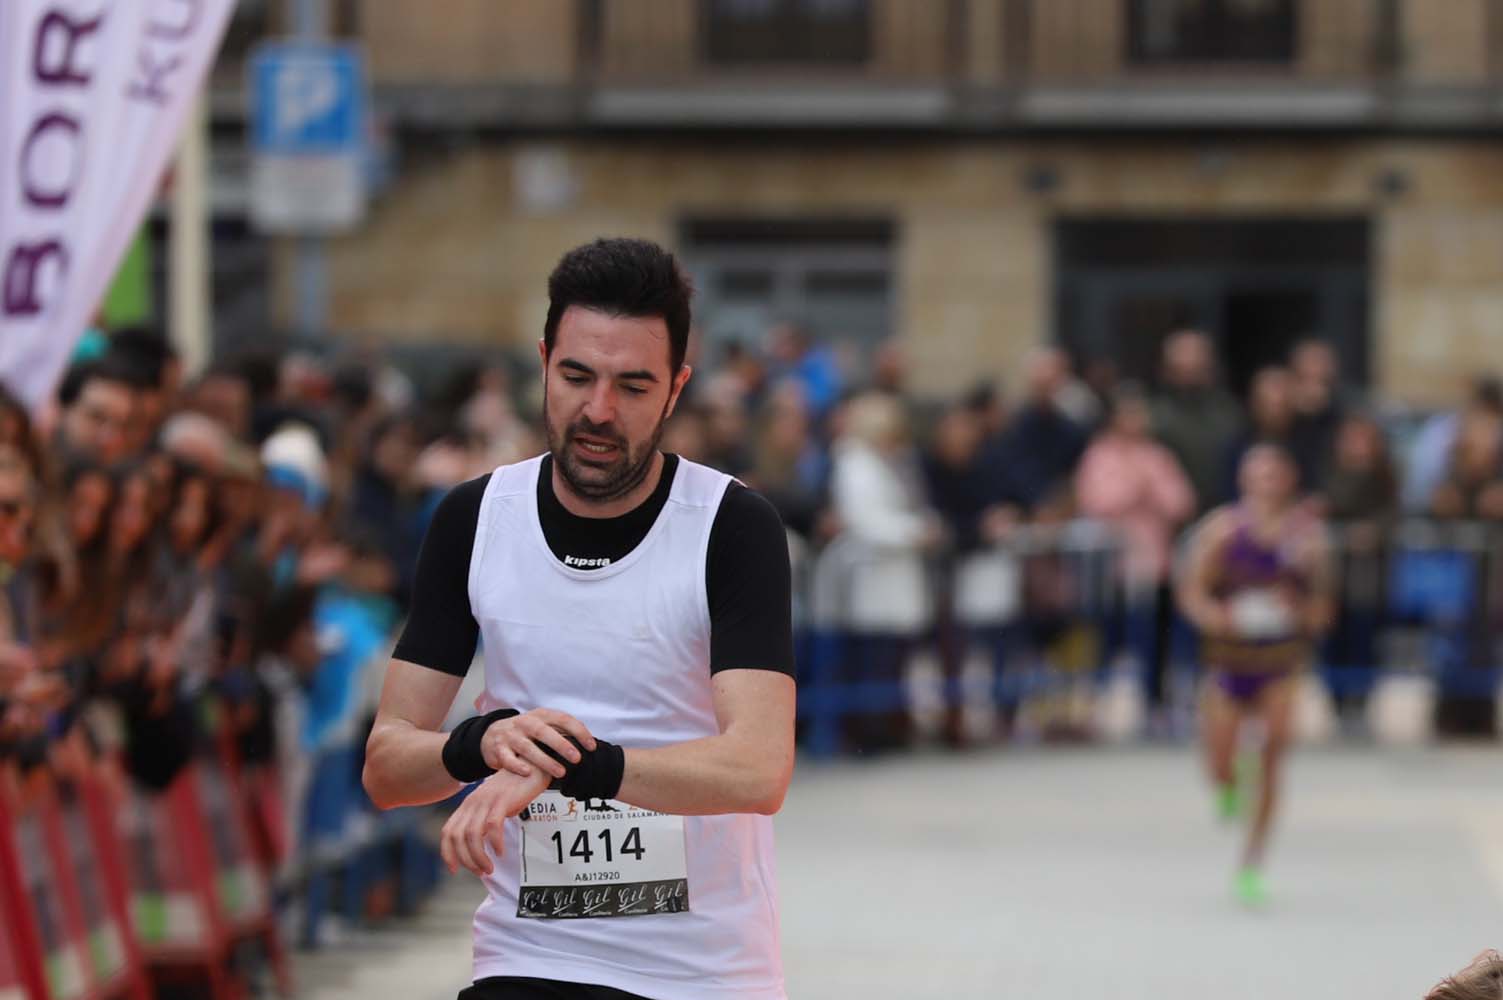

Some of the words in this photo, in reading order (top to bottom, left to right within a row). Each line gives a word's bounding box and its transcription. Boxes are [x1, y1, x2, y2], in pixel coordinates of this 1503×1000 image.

[564, 554, 610, 567] kipsta
[530, 802, 557, 814] EDIA
[583, 813, 612, 821] CIUDAD
[551, 826, 646, 865] 1414
[574, 871, 620, 882] A&J12920
